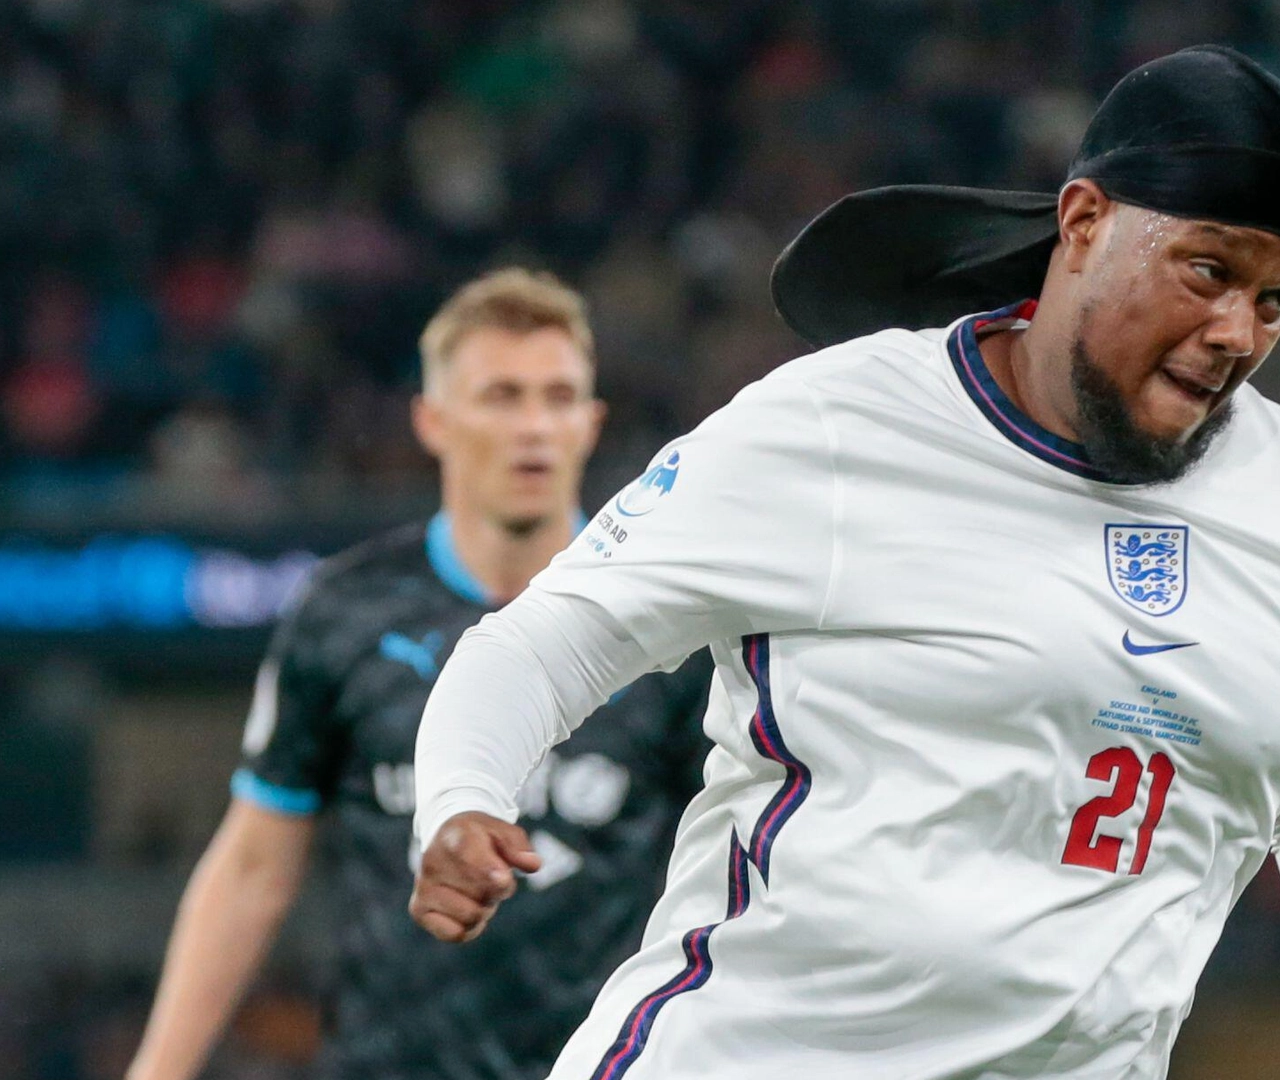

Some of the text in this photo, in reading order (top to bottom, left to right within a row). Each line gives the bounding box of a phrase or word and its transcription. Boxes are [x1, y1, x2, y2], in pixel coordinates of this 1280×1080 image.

[610, 524, 628, 543] AID
[1141, 685, 1177, 699] ENGLAND
[1110, 701, 1137, 711] SOCCER
[1138, 705, 1151, 714] AID
[1152, 708, 1178, 719] WORLD
[1098, 709, 1134, 721] SATURDAY
[1142, 718, 1183, 730] SEPTEMBER
[1155, 731, 1200, 745] MANCHESTER
[1061, 746, 1176, 875] 21
